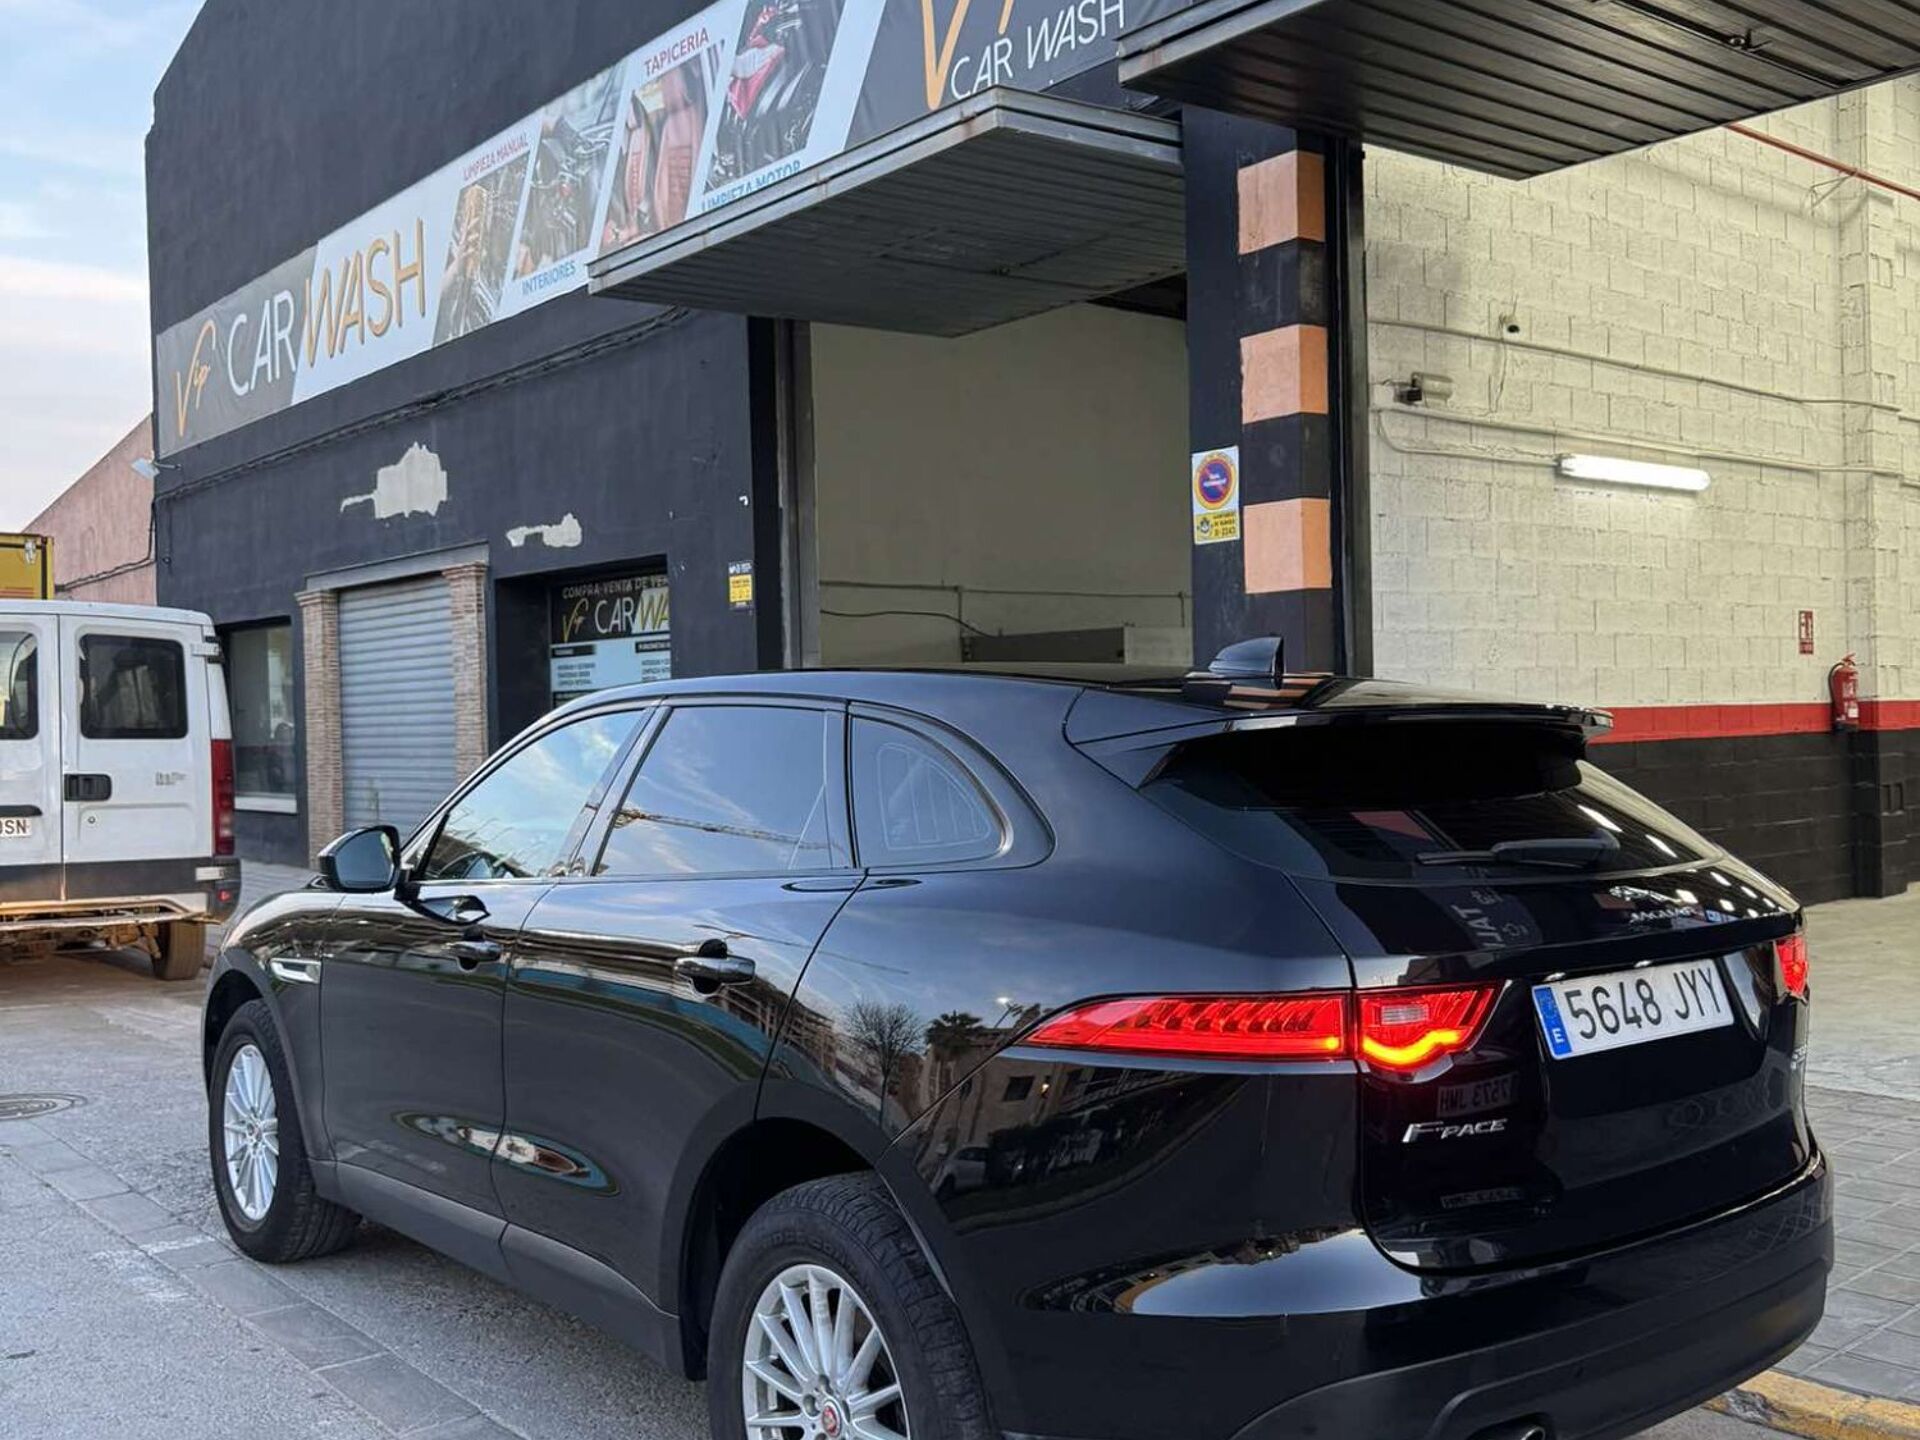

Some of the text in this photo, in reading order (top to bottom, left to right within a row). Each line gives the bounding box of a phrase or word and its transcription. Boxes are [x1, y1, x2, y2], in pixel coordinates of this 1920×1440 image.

[644, 26, 710, 77] TAPICERIA
[950, 37, 1014, 101] CAR
[1026, 0, 1126, 70] WASH
[521, 260, 577, 297] INTERIORES
[0, 818, 28, 836] SN
[1552, 966, 1722, 1044] E 5648 JYY
